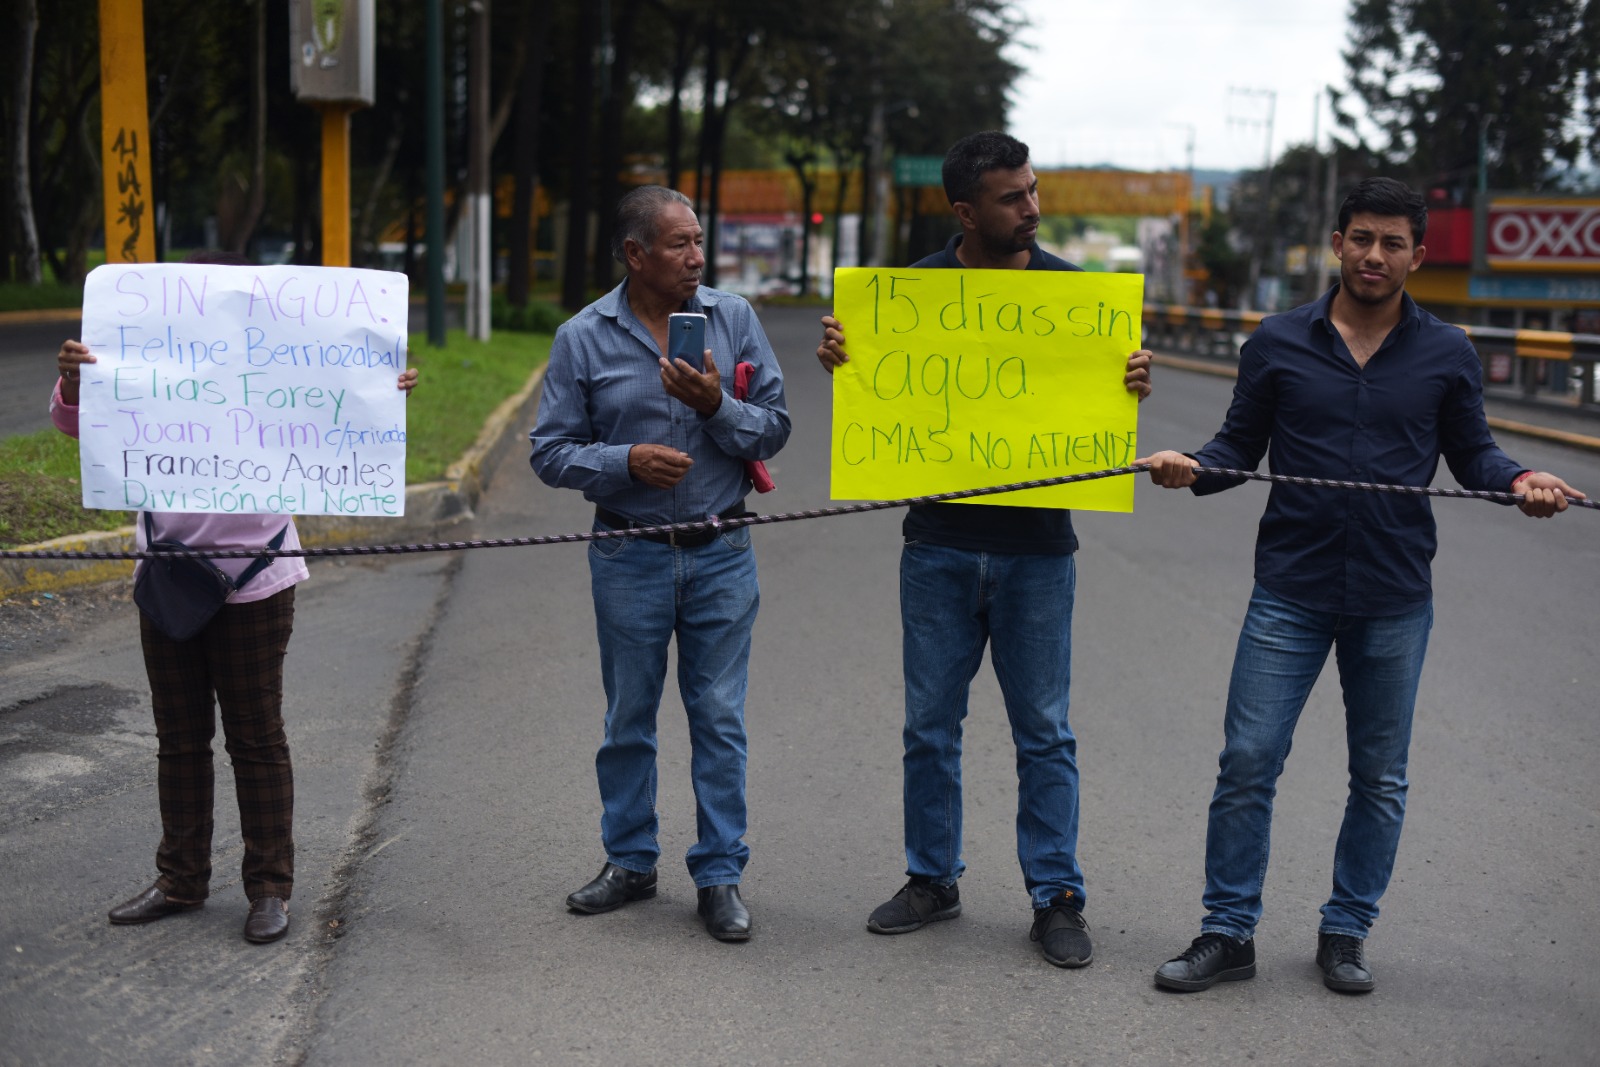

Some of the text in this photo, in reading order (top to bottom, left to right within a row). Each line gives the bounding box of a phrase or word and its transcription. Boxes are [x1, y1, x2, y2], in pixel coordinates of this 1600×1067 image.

[115, 270, 389, 326] SIN AGUA:
[865, 273, 1133, 341] 15 días sin
[117, 324, 229, 372] Felipe
[244, 326, 402, 370] Berriozabal
[114, 366, 227, 405] Elias
[237, 372, 346, 425] Forey
[873, 350, 1035, 434] agua.
[117, 409, 212, 448] Juan
[226, 408, 321, 449] Prim
[842, 422, 1136, 471] CMAS NO ATIENDE
[122, 450, 272, 482] Francisco
[282, 451, 395, 492] Aquiles
[123, 480, 258, 512] División
[266, 482, 306, 514] del
[324, 483, 397, 515] Norte
